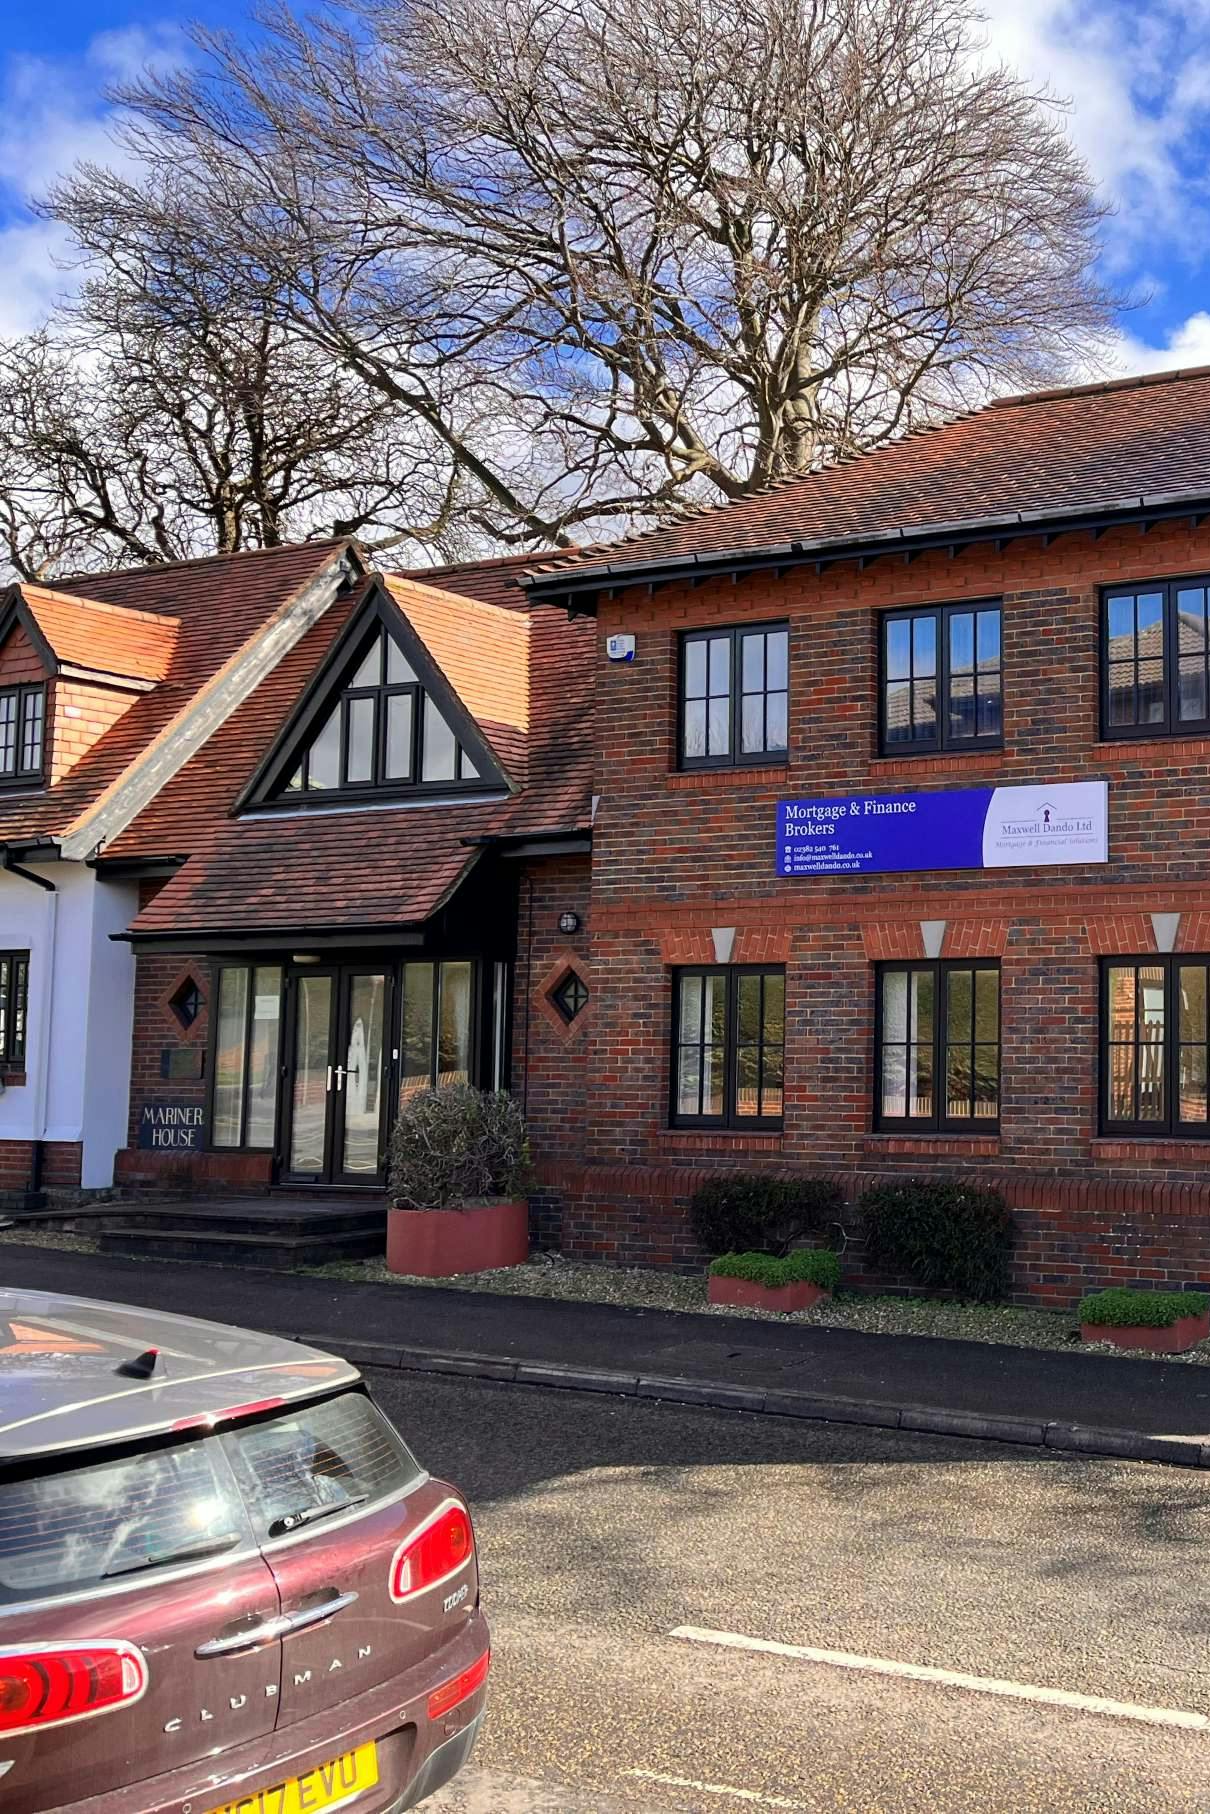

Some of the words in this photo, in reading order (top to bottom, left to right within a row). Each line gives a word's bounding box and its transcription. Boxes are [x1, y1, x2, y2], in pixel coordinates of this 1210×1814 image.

[785, 805, 847, 820] Mortgage
[849, 801, 861, 815] &
[864, 800, 916, 814] Finance
[785, 821, 835, 837] Brokers
[1001, 823, 1040, 835] Maxwell
[1043, 821, 1074, 833] Dando
[1076, 820, 1093, 831] Ltd
[793, 860, 861, 871] maxwelldando.co.uk
[142, 1107, 204, 1126] MARINER
[152, 1128, 197, 1147] HOUSE
[163, 1645, 372, 1733] CLUBMAN
[297, 1751, 358, 1810] EVU
